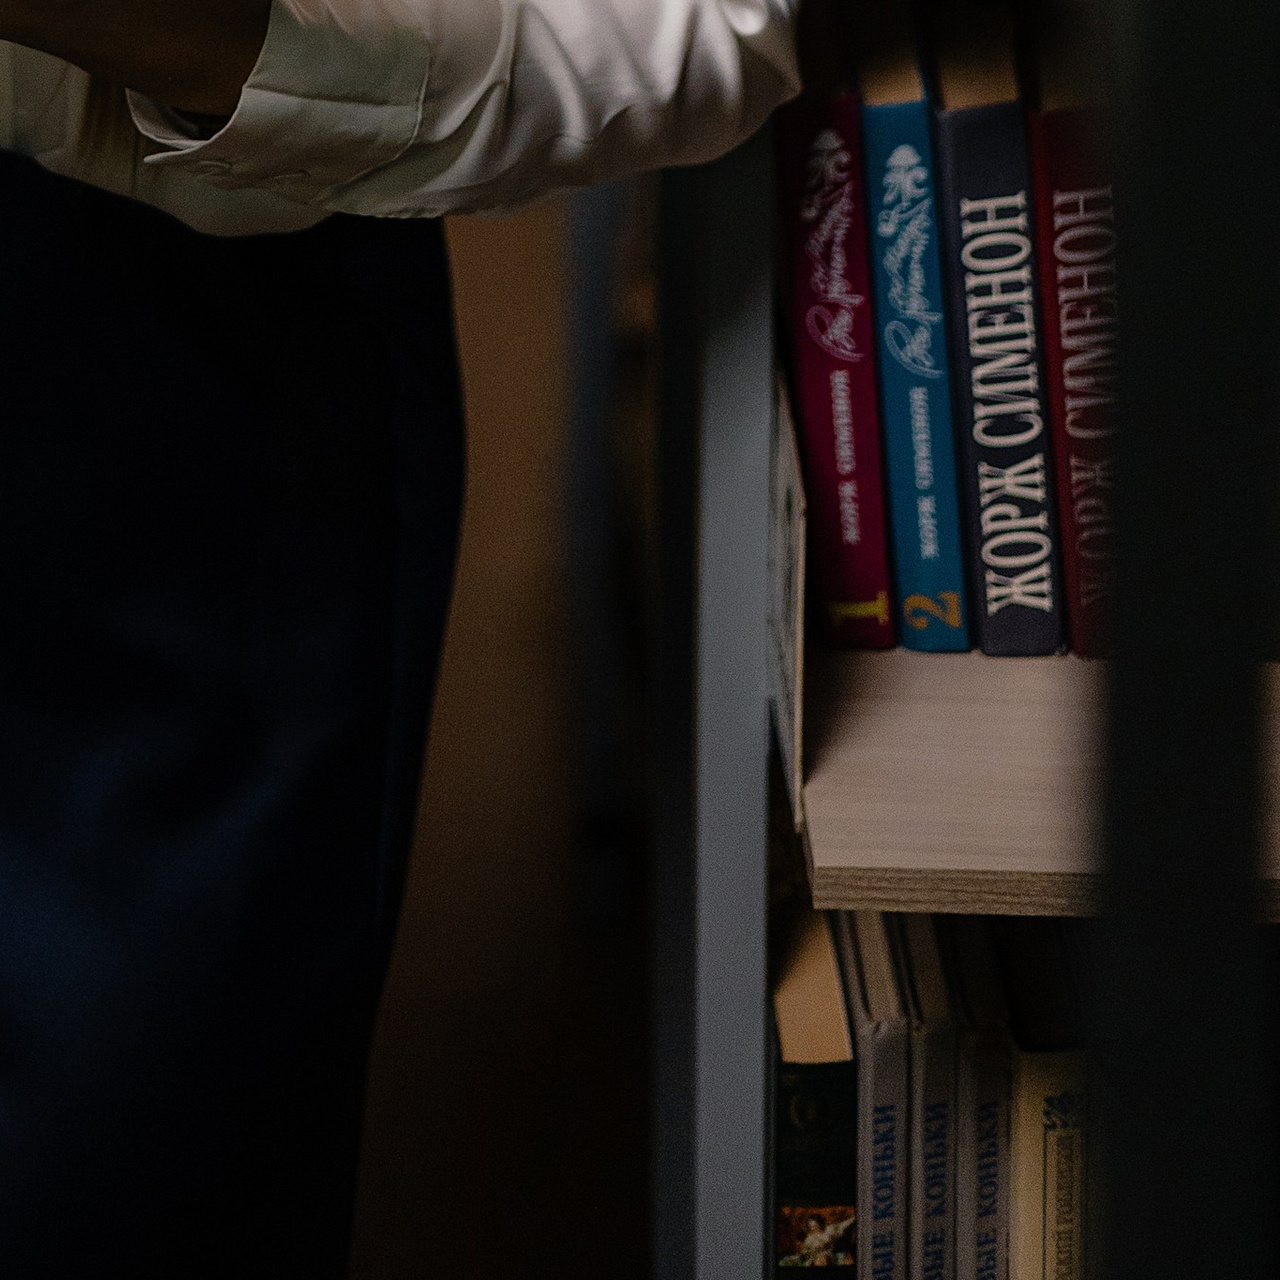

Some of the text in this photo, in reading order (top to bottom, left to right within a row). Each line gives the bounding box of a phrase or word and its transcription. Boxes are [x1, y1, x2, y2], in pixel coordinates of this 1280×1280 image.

[960, 190, 1052, 614] ЖОРЖ СИМЕНОН
[831, 590, 888, 630] 1
[903, 590, 962, 630] 2
[874, 1104, 896, 1221] КОНЬКИ
[923, 1101, 948, 1218] КОНЬКИ
[976, 1100, 1000, 1218] КОНЬКИ
